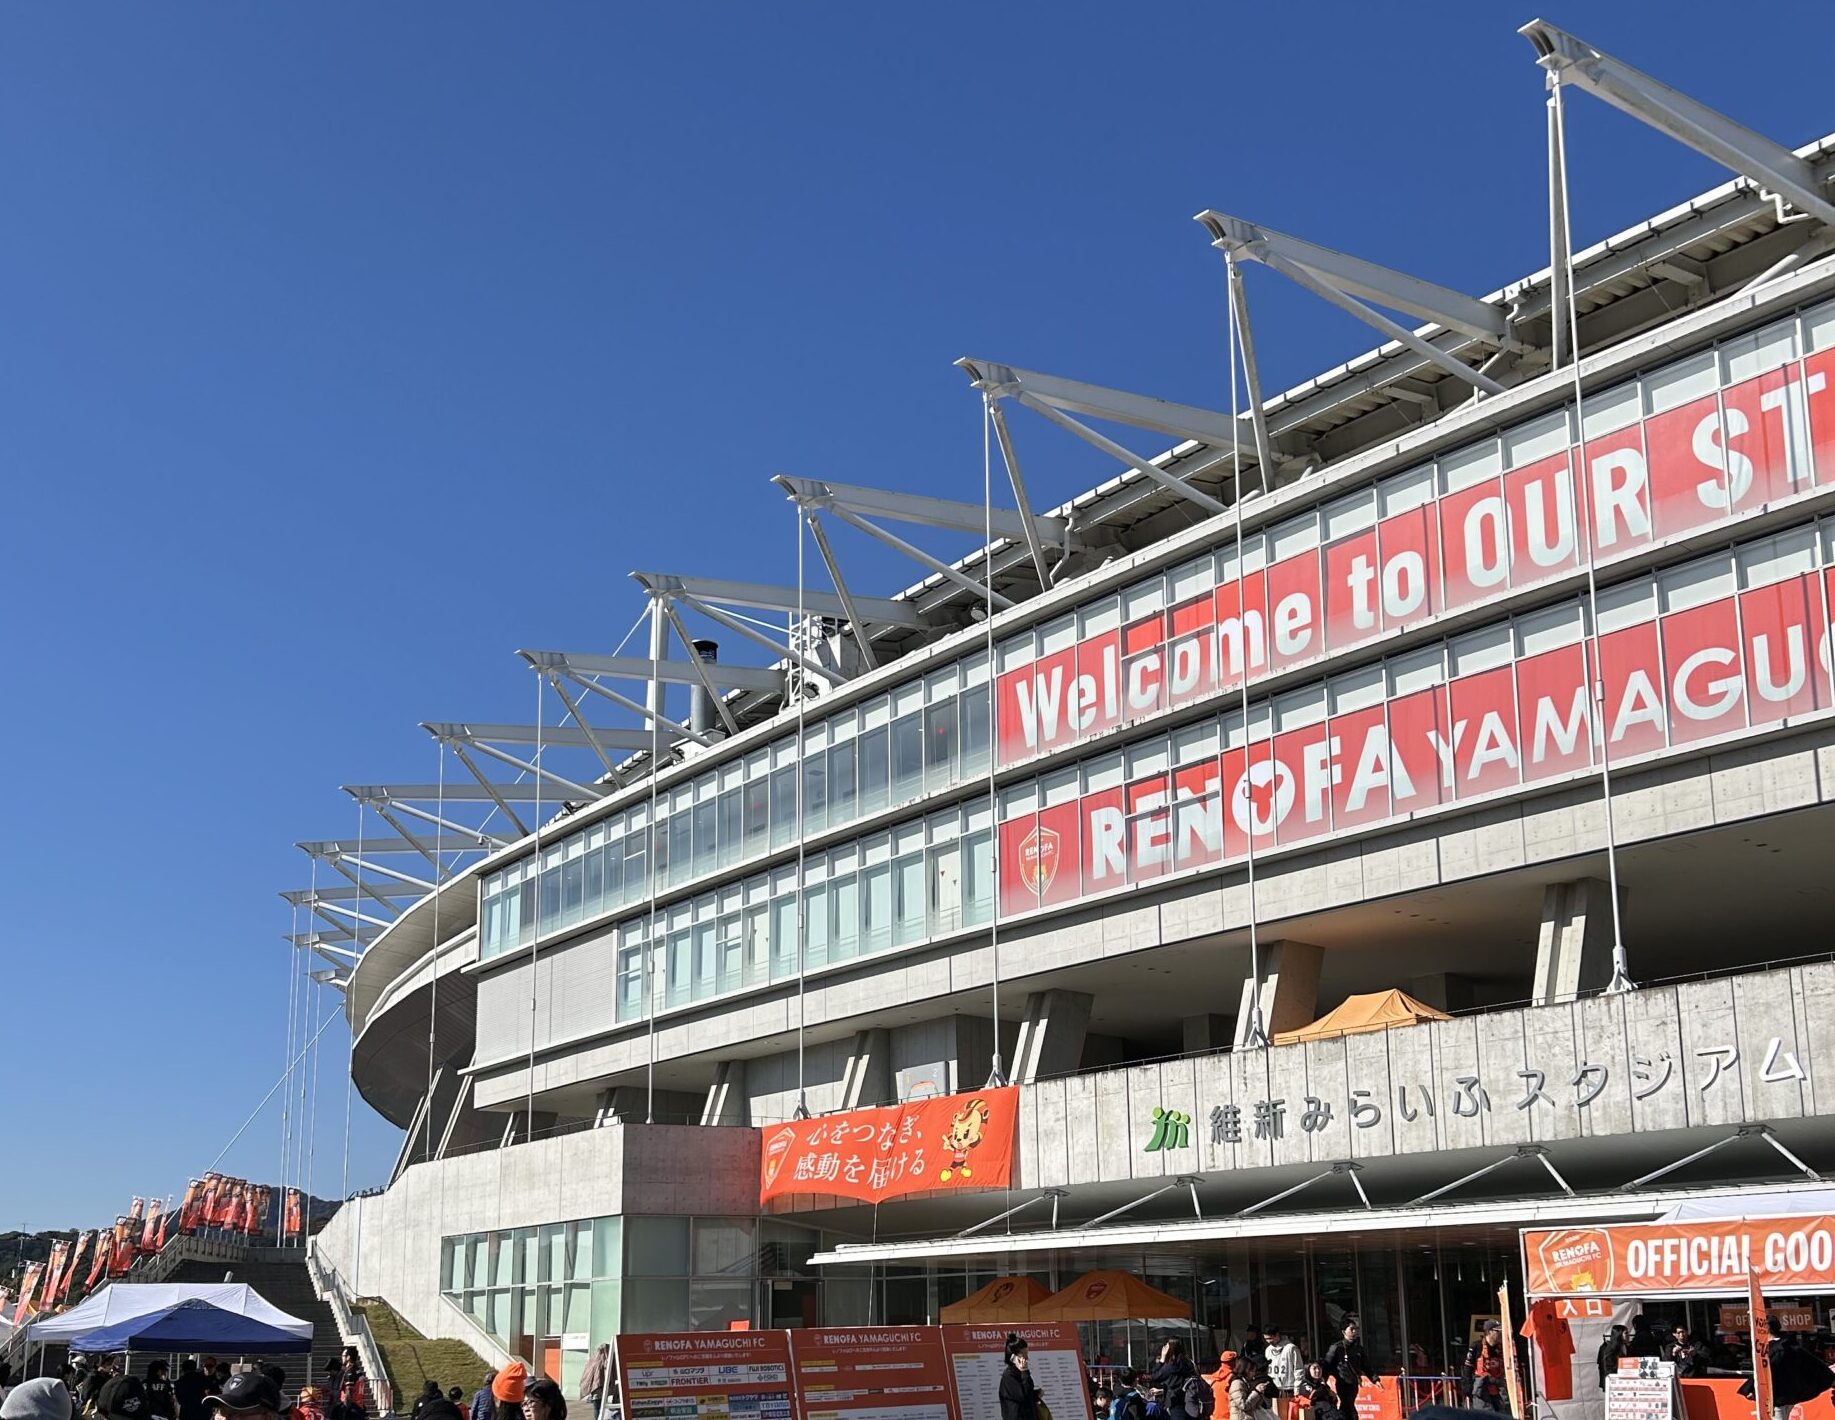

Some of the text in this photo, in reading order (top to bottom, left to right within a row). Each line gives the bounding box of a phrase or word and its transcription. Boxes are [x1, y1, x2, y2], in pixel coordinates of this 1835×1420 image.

[1016, 371, 1827, 748] Welcome to OUR ST
[1090, 621, 1835, 880] RENOFA YAMAGU
[1209, 1036, 1808, 1144] 維新みらいふスタジアム
[804, 1115, 923, 1151] 心をつなぎ、
[792, 1148, 927, 1190] 感動を届ける
[1551, 1241, 1600, 1262] RENOFA
[1627, 1229, 1833, 1279] OFFICIAL GOO
[1562, 1298, 1603, 1316] 入口
[1782, 1314, 1811, 1326] SHOP
[654, 1337, 766, 1351] RENOFA YAMAGUCHI FC
[823, 1332, 922, 1345] RENOFA YAMAGUCHI FC
[972, 1330, 1002, 1340] RENOFA
[1050, 1329, 1060, 1338] FC
[718, 1366, 738, 1374] UBE
[671, 1376, 709, 1386] FRONTIER
